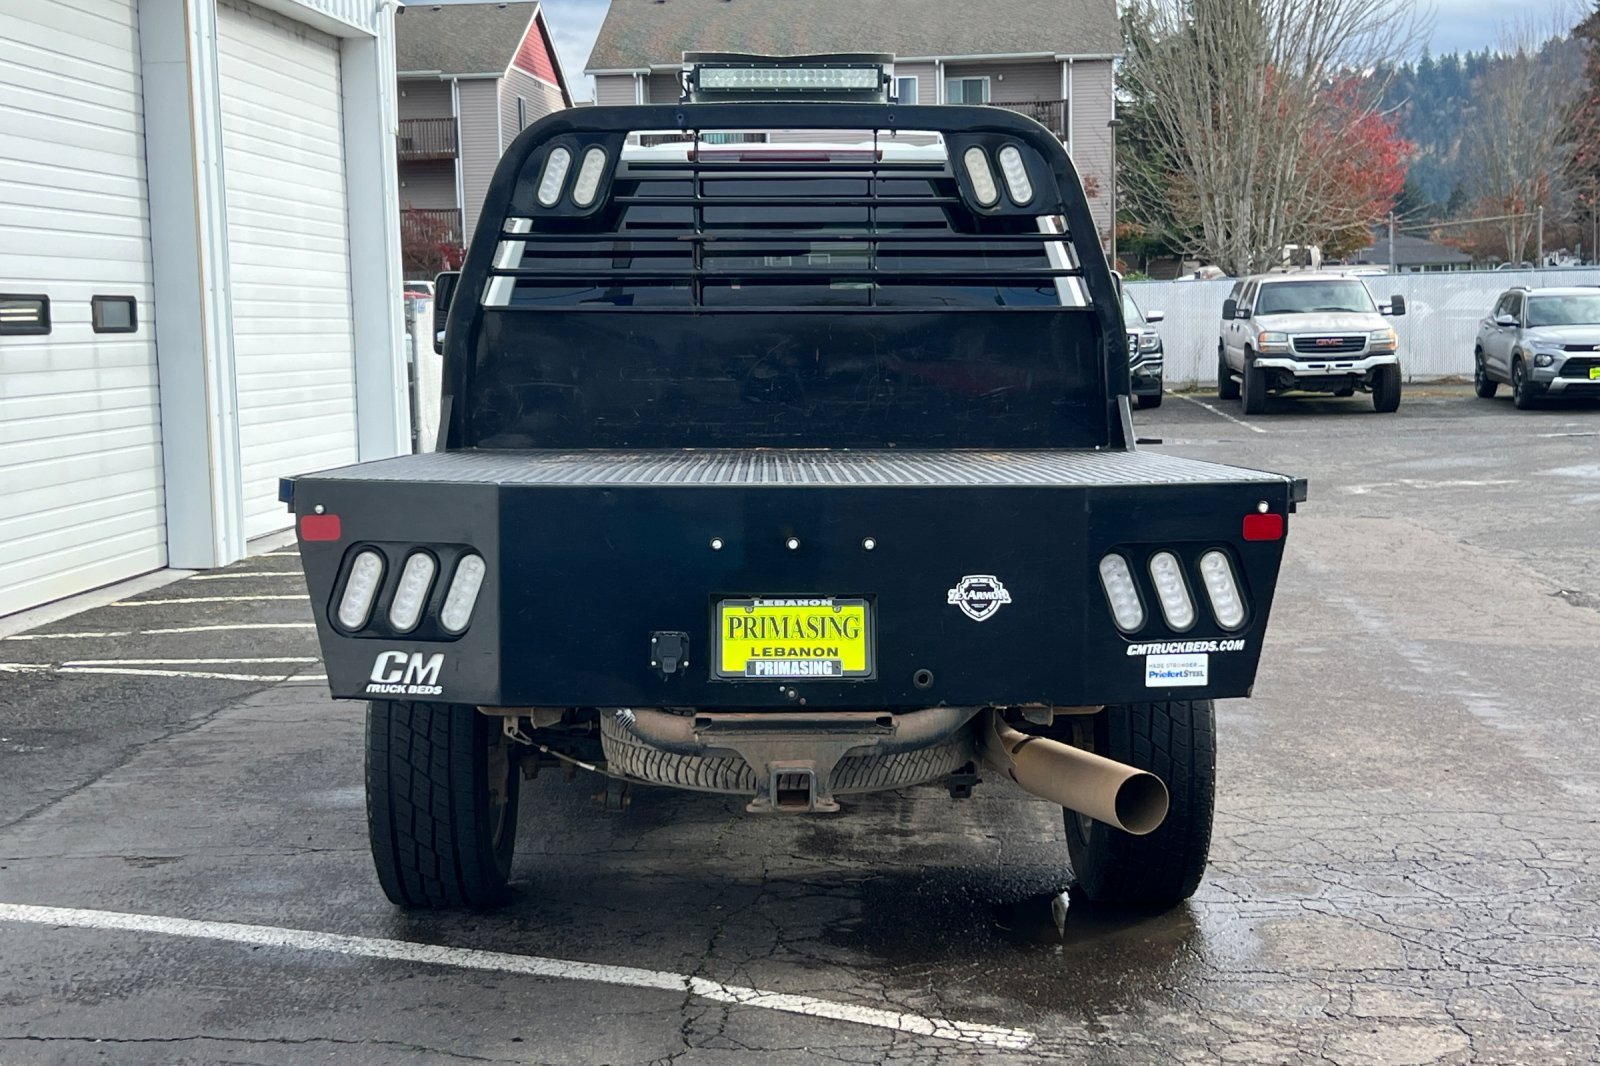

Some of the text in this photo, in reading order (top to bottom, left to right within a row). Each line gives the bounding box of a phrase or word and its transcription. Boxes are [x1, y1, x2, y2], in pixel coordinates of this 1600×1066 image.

[1315, 338, 1344, 346] GMC
[753, 599, 833, 607] LEBANON
[726, 615, 861, 641] PRIMASING
[751, 647, 839, 657] LEBANON
[1126, 639, 1246, 656] CMTRUCKBEDS.COM
[370, 650, 445, 686] CM
[755, 660, 833, 676] PRIMASING
[366, 683, 443, 695] TRUCK BEDS
